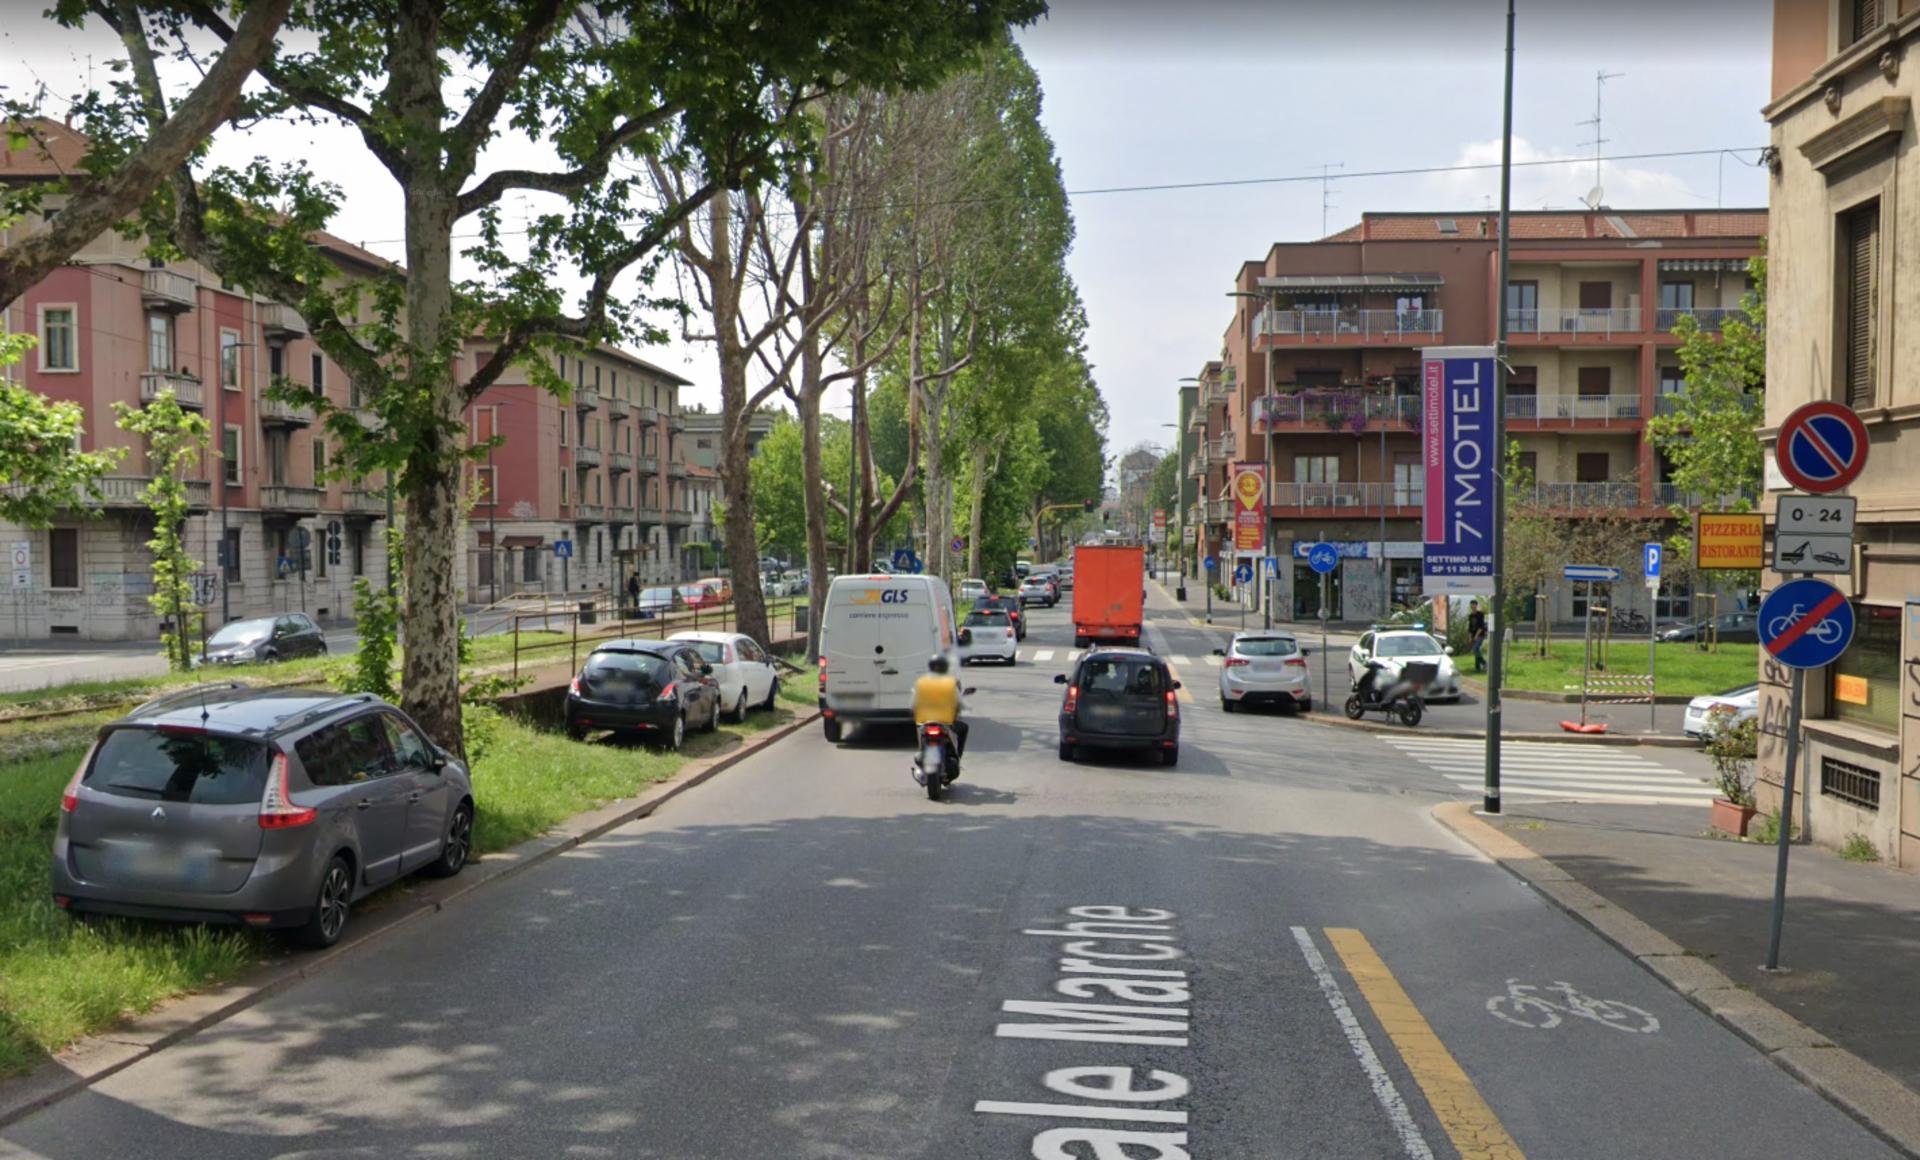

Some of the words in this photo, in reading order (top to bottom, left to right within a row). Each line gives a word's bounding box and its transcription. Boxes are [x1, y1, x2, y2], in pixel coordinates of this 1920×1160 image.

[1791, 508, 1804, 521] 0
[1819, 508, 1842, 522] 24
[1702, 523, 1761, 537] PIZZERIA
[1701, 544, 1761, 558] RISTORANTE
[1426, 555, 1468, 564] SETTIMO
[1648, 548, 1659, 572] P
[1431, 565, 1444, 574] SP
[881, 589, 909, 604] GLS
